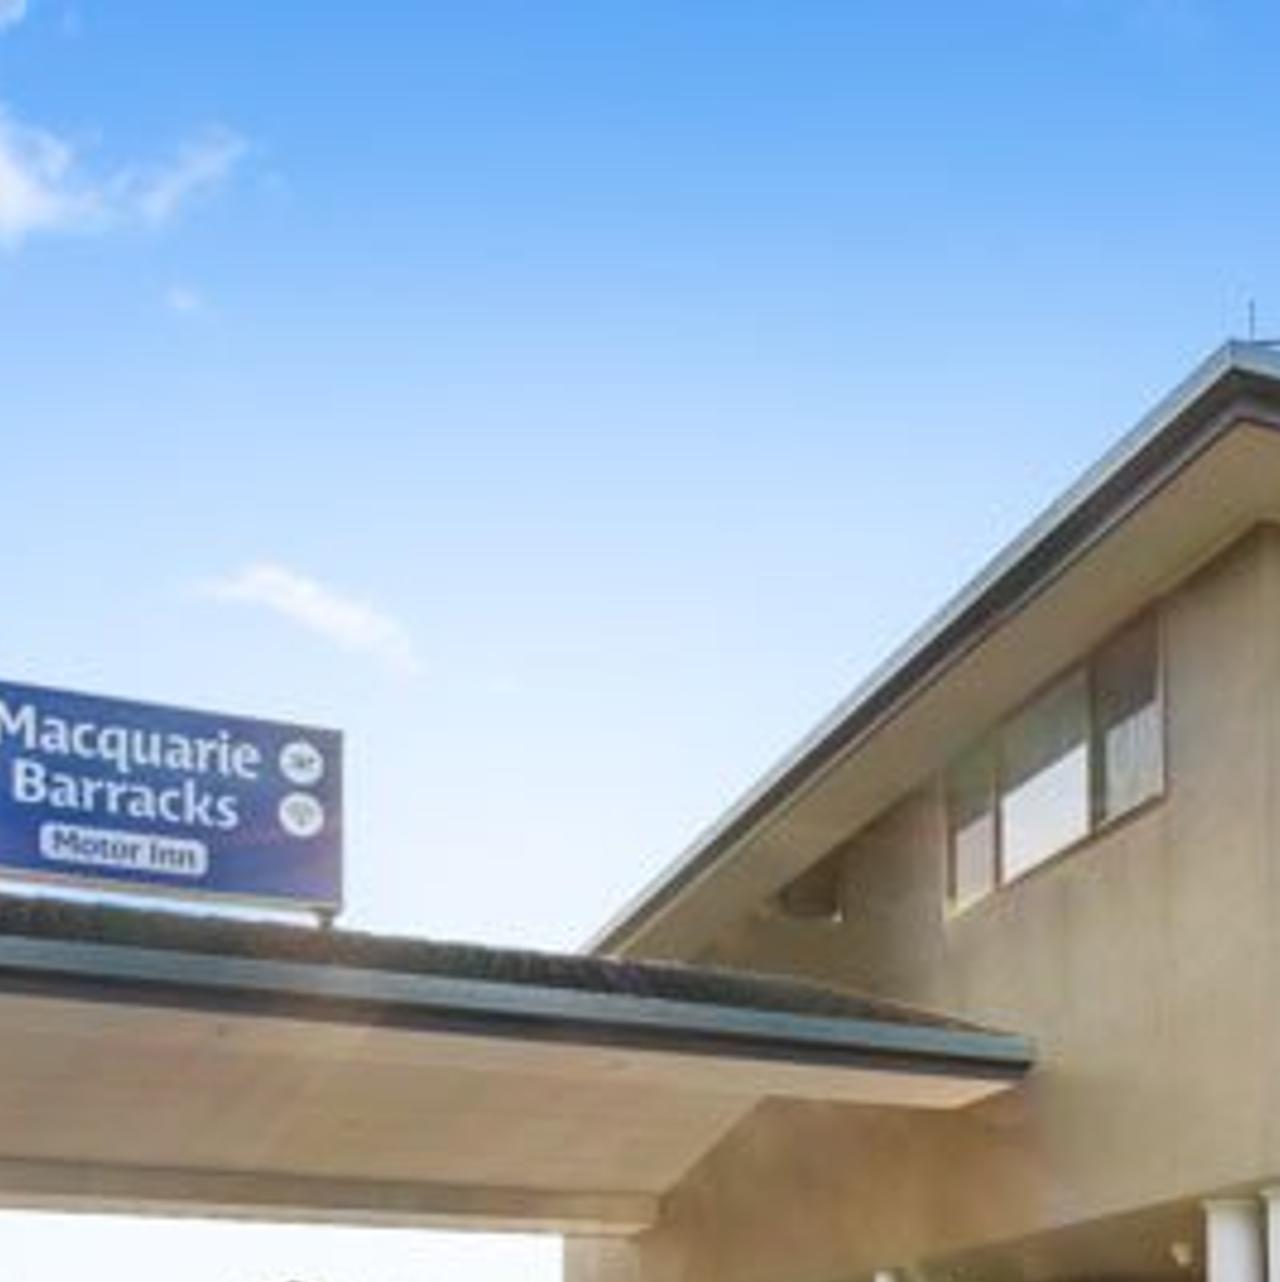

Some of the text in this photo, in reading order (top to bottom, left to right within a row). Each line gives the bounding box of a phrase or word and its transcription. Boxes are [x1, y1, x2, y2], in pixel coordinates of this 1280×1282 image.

[13, 757, 239, 830] Barracks
[53, 829, 196, 868] Motor Inn
